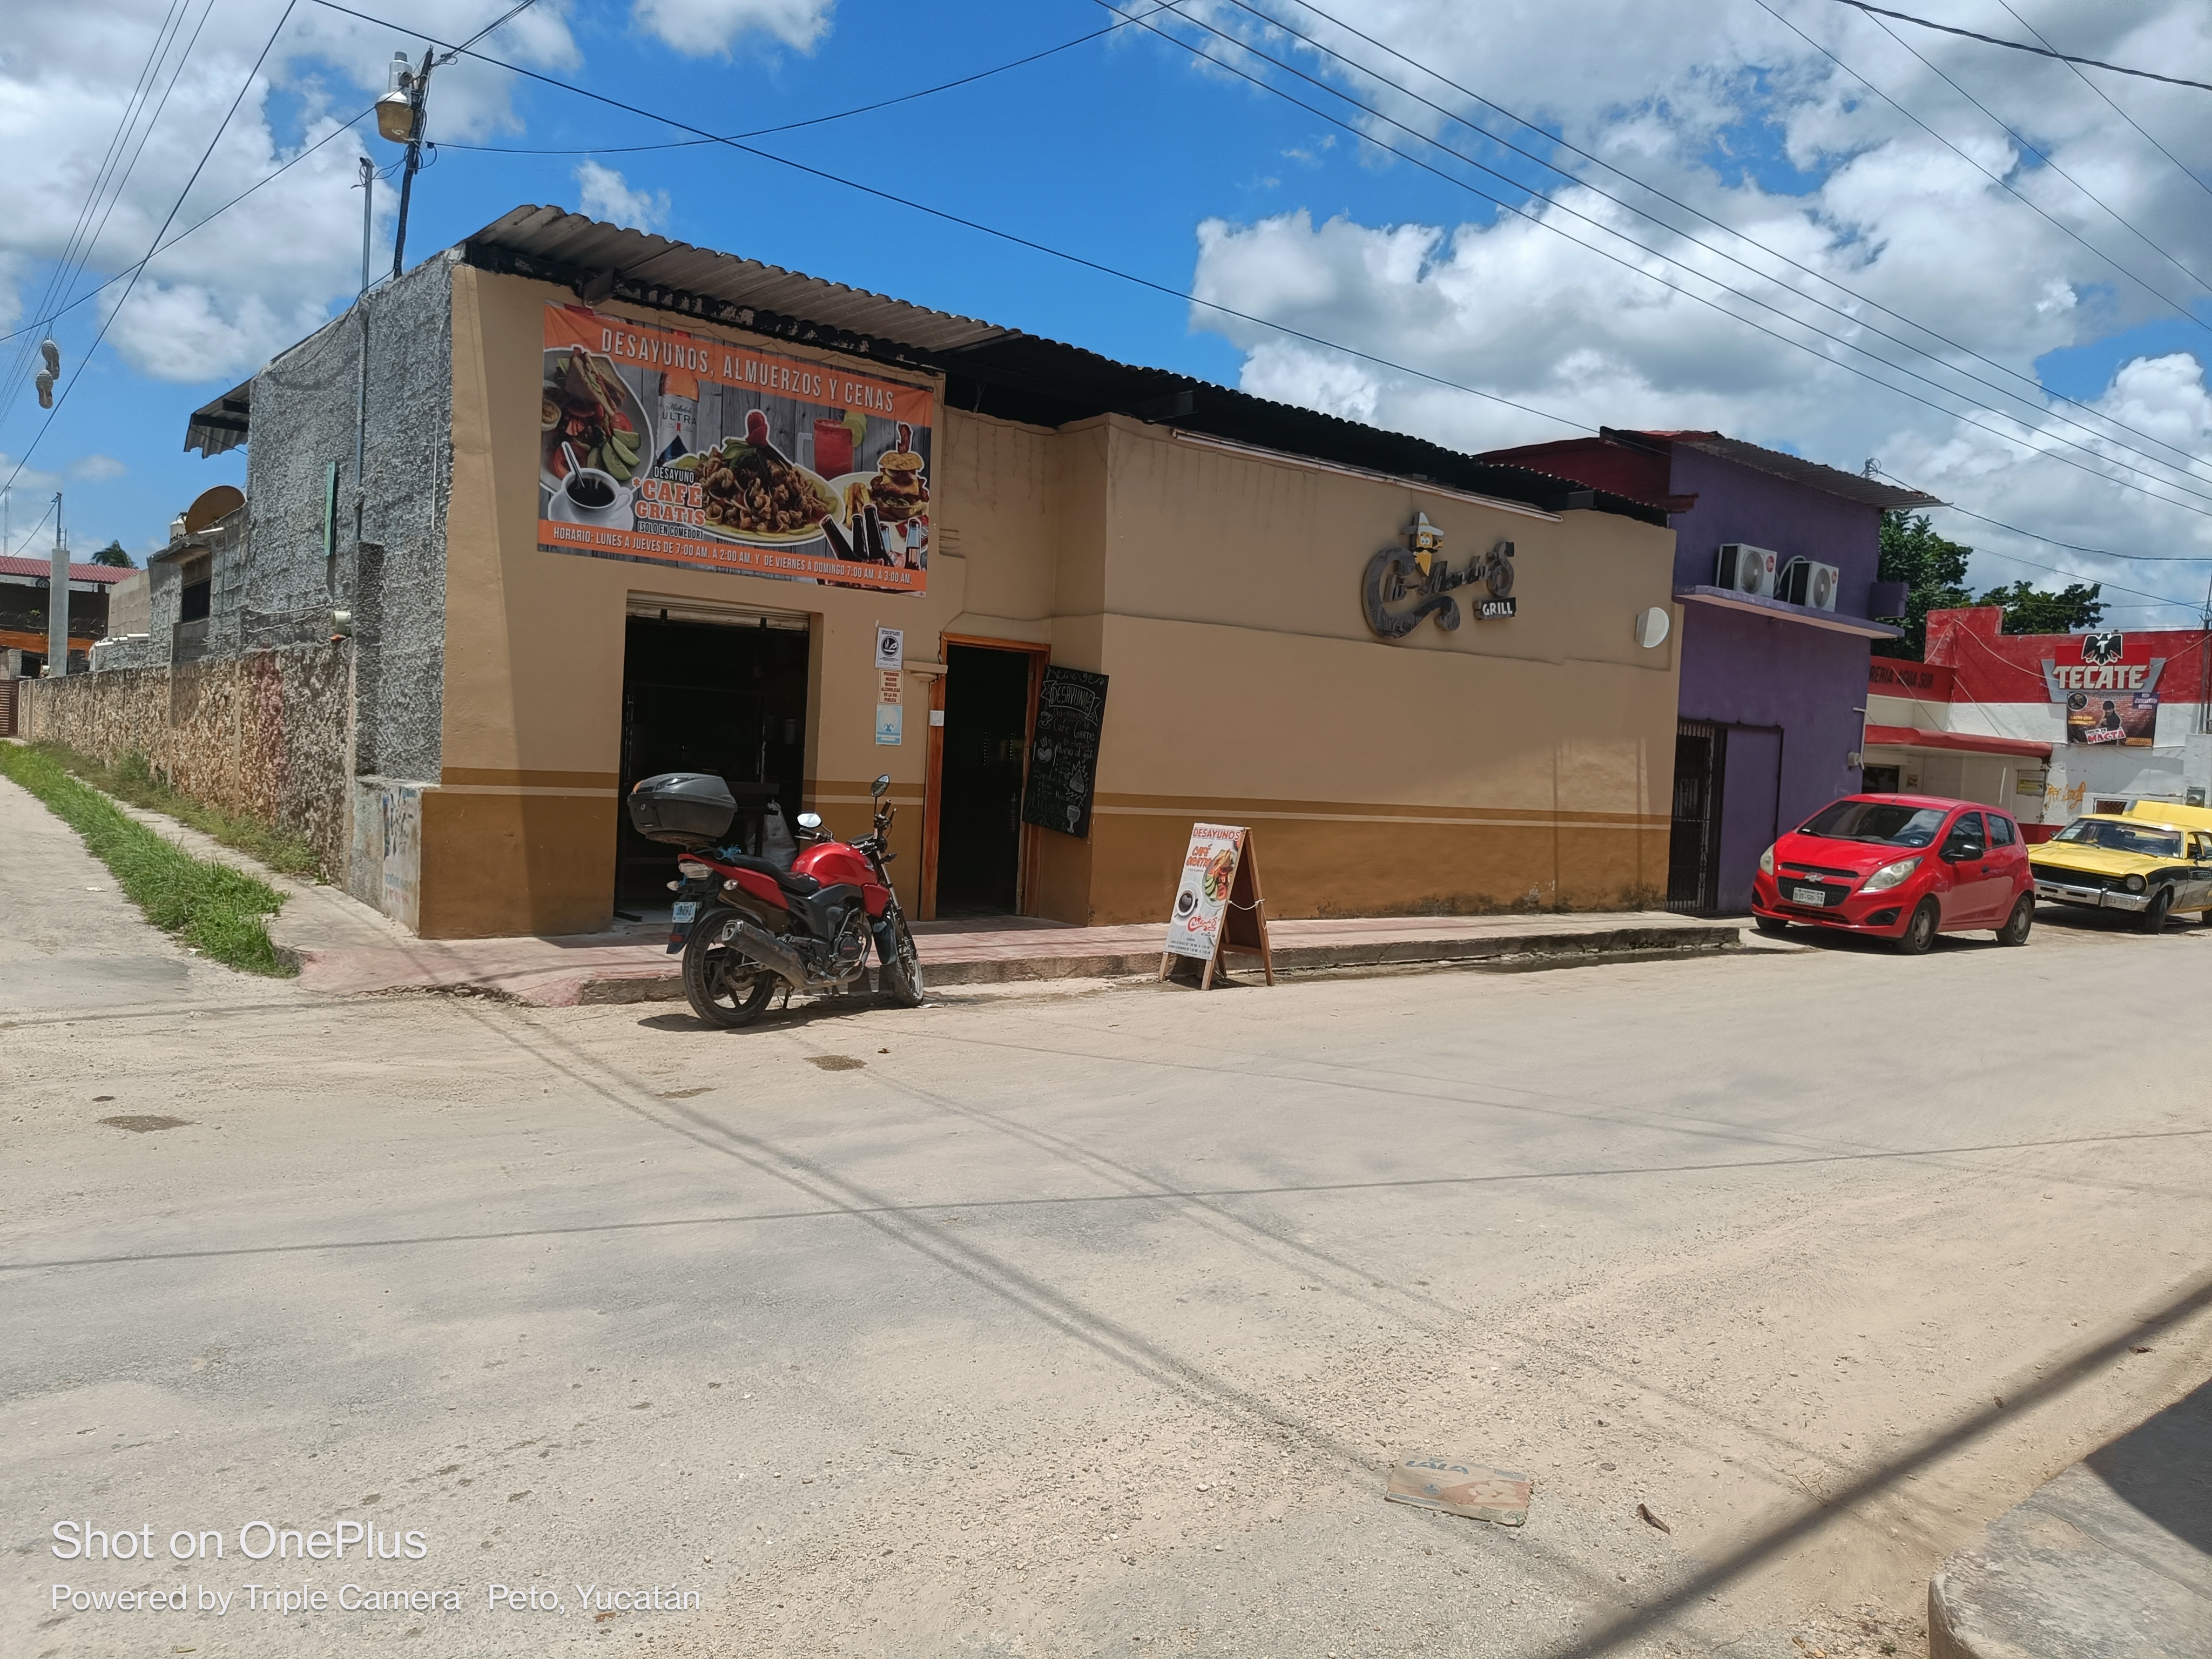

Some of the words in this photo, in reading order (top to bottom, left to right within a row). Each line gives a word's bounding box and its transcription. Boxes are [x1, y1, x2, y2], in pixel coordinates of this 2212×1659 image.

[602, 328, 714, 377] DESAYUNOS,
[723, 356, 821, 397] ALMUERZOS
[830, 378, 838, 400] Y
[845, 382, 893, 413] CENAS
[662, 412, 697, 426] ULTRA
[655, 466, 694, 483] DESAYUNO
[636, 501, 705, 526] GRATIS
[638, 522, 657, 534] (SOLO
[659, 525, 667, 535] EN
[670, 527, 703, 539] COMEDOR)
[554, 527, 594, 544] HORARIO:
[596, 532, 622, 547] LUNES
[632, 537, 661, 552] JUEVES
[663, 541, 673, 554] DE
[676, 543, 693, 556] 7:00
[696, 546, 710, 558] AM.
[720, 549, 737, 562] 2:00
[739, 551, 753, 564] AM.
[756, 554, 760, 565] Y
[764, 555, 774, 567] DE
[775, 556, 805, 571] VIERNES
[814, 562, 845, 576] DOMINGO
[847, 565, 862, 578] 7:00
[864, 568, 876, 580] AM.
[884, 570, 899, 583] 3:00
[900, 573, 913, 584] AM.
[1482, 602, 1512, 616] GRILL
[2052, 665, 2148, 690] TECATE
[1051, 685, 1093, 712] DESAYUNOS
[1192, 827, 1240, 841] DESAYUNOS
[1192, 844, 1213, 857] CAFÉ
